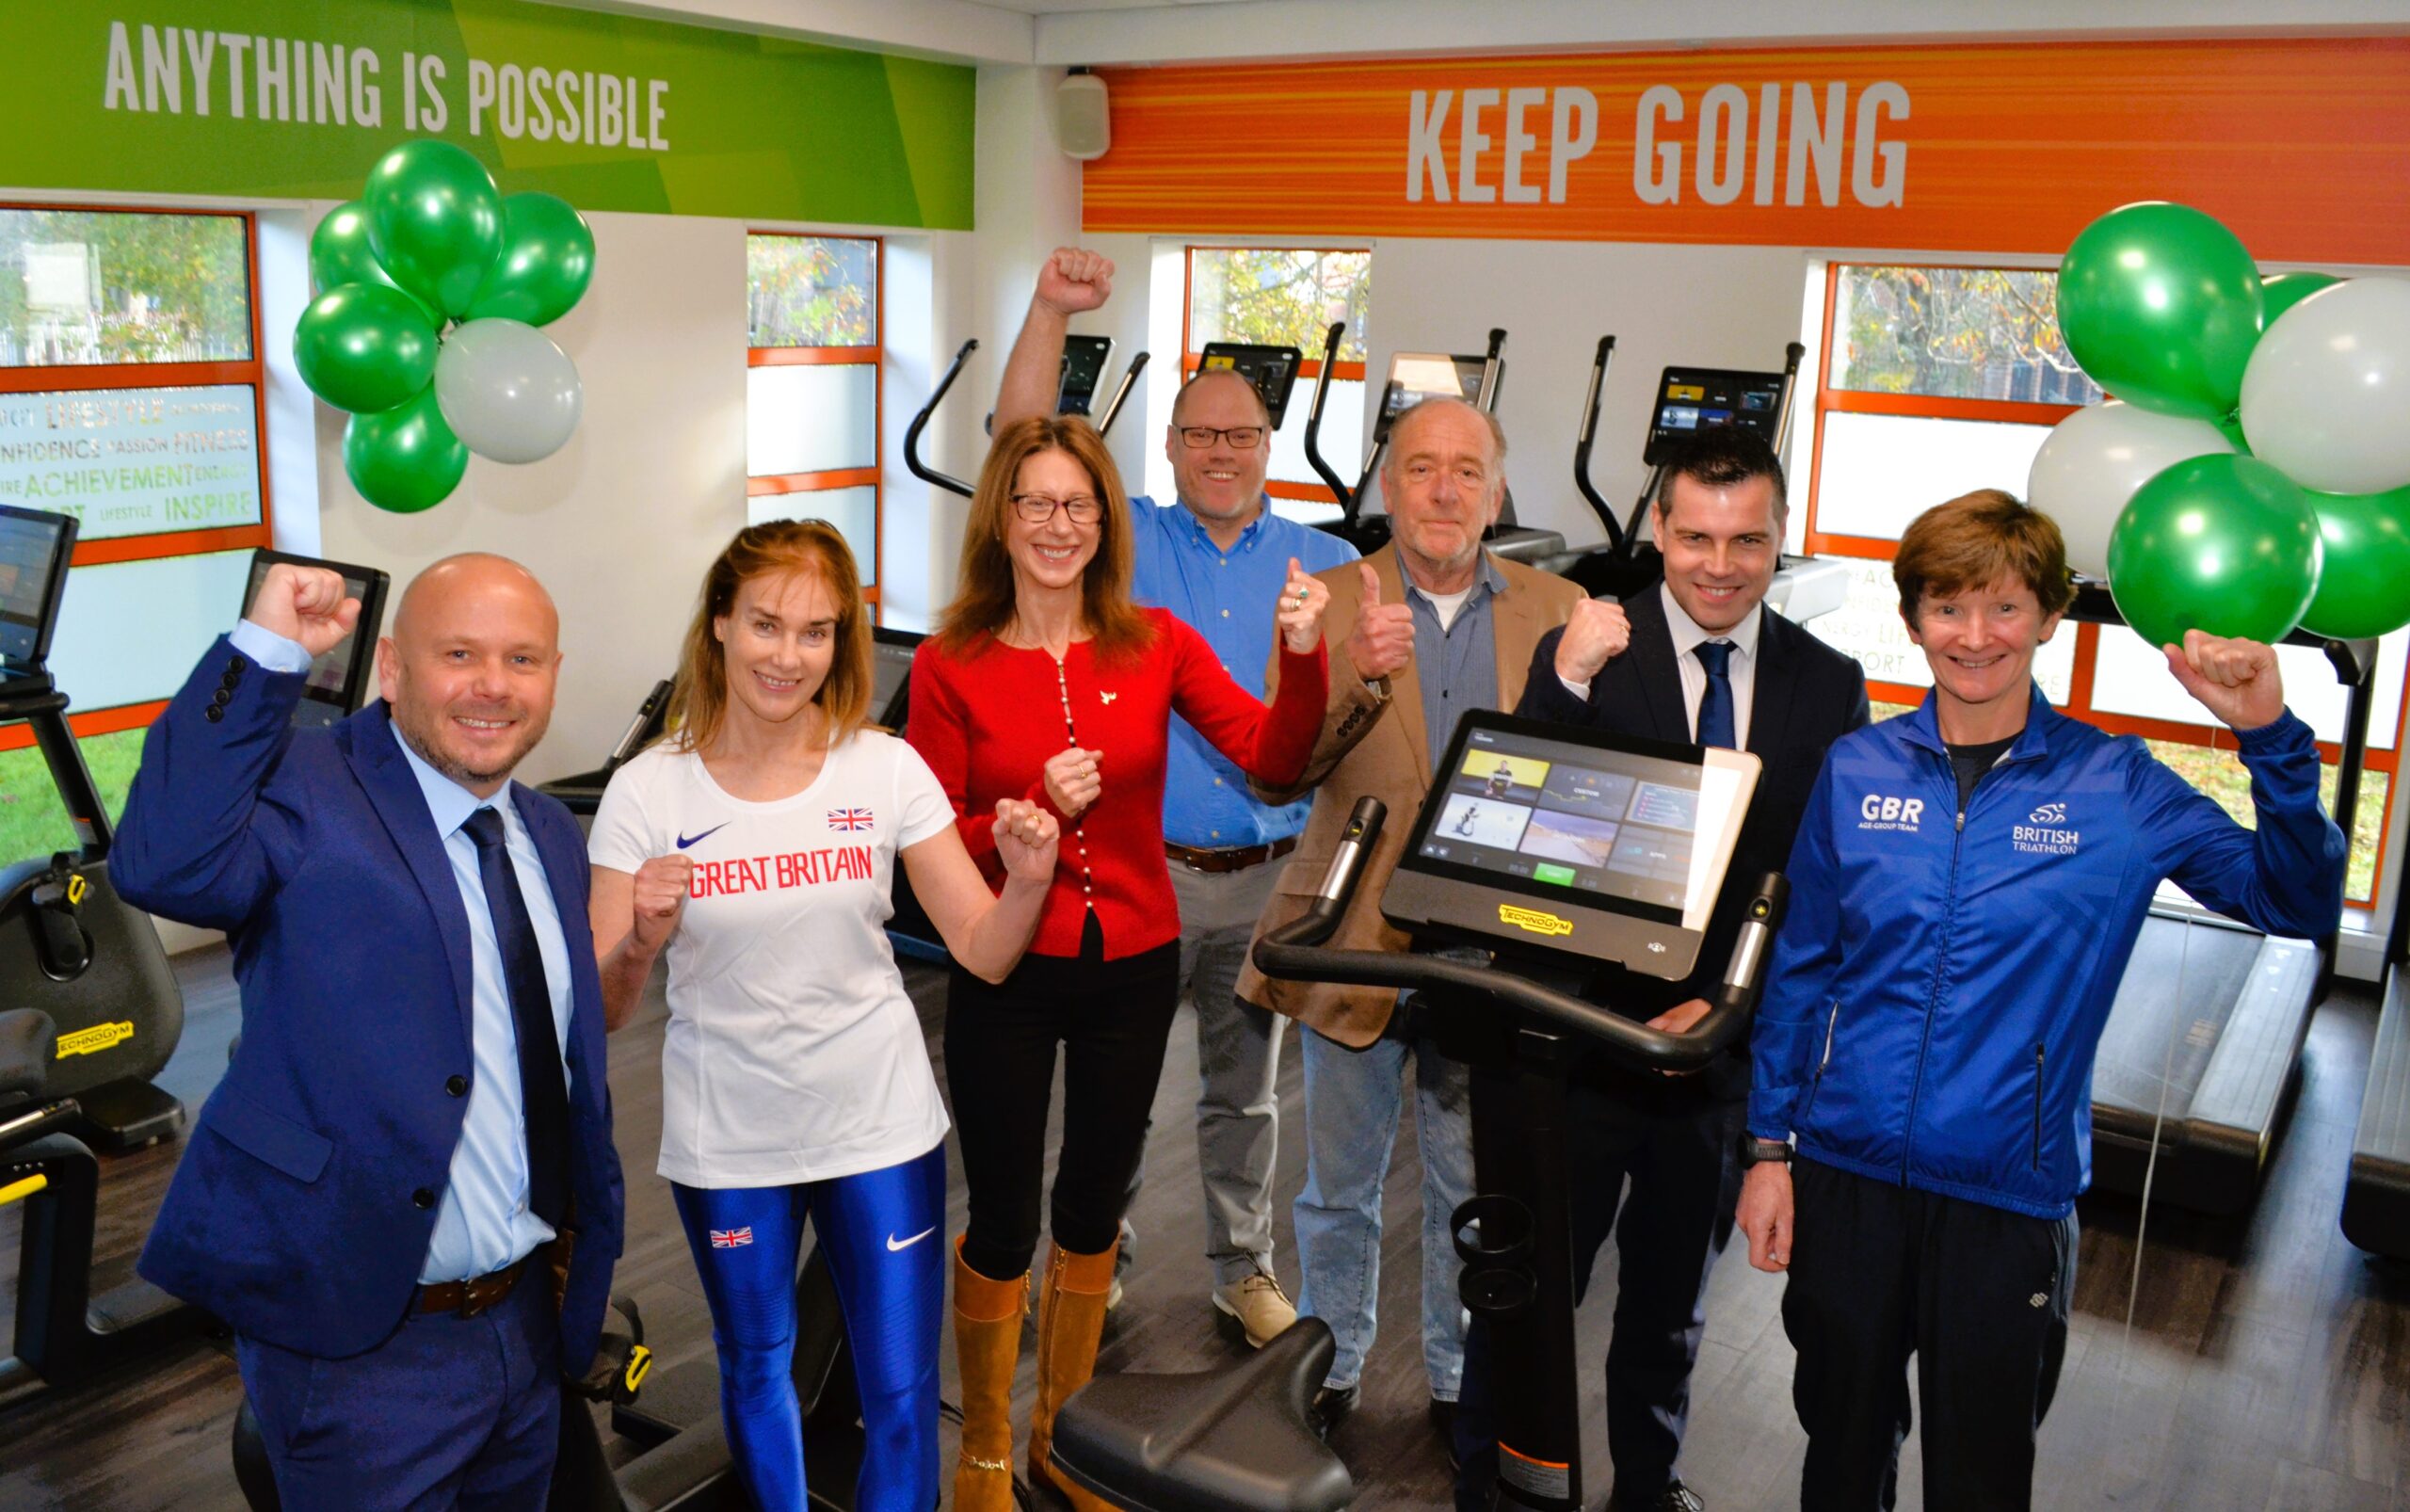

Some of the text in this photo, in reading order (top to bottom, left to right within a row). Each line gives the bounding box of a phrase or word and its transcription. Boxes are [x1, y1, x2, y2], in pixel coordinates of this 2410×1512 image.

[104, 21, 670, 152] ANYTHING IS POSSIBLE
[1406, 81, 1910, 208] KEEP GOING
[45, 397, 164, 428] LIFESTYLE
[173, 428, 249, 454] FITNESS
[24, 463, 193, 498] ACHIEVEMENT
[100, 505, 153, 521] LIFESTYLE
[165, 491, 251, 522] INSPIRE
[1861, 794, 1924, 824] GBR
[1858, 822, 1919, 832] AGE-GROUP TEAM
[2012, 825, 2080, 845] BRITISH
[2012, 840, 2078, 855] TRIATHLON
[689, 845, 873, 899] GREAT BRITAIN
[1502, 906, 1570, 931] TECHNOGYM
